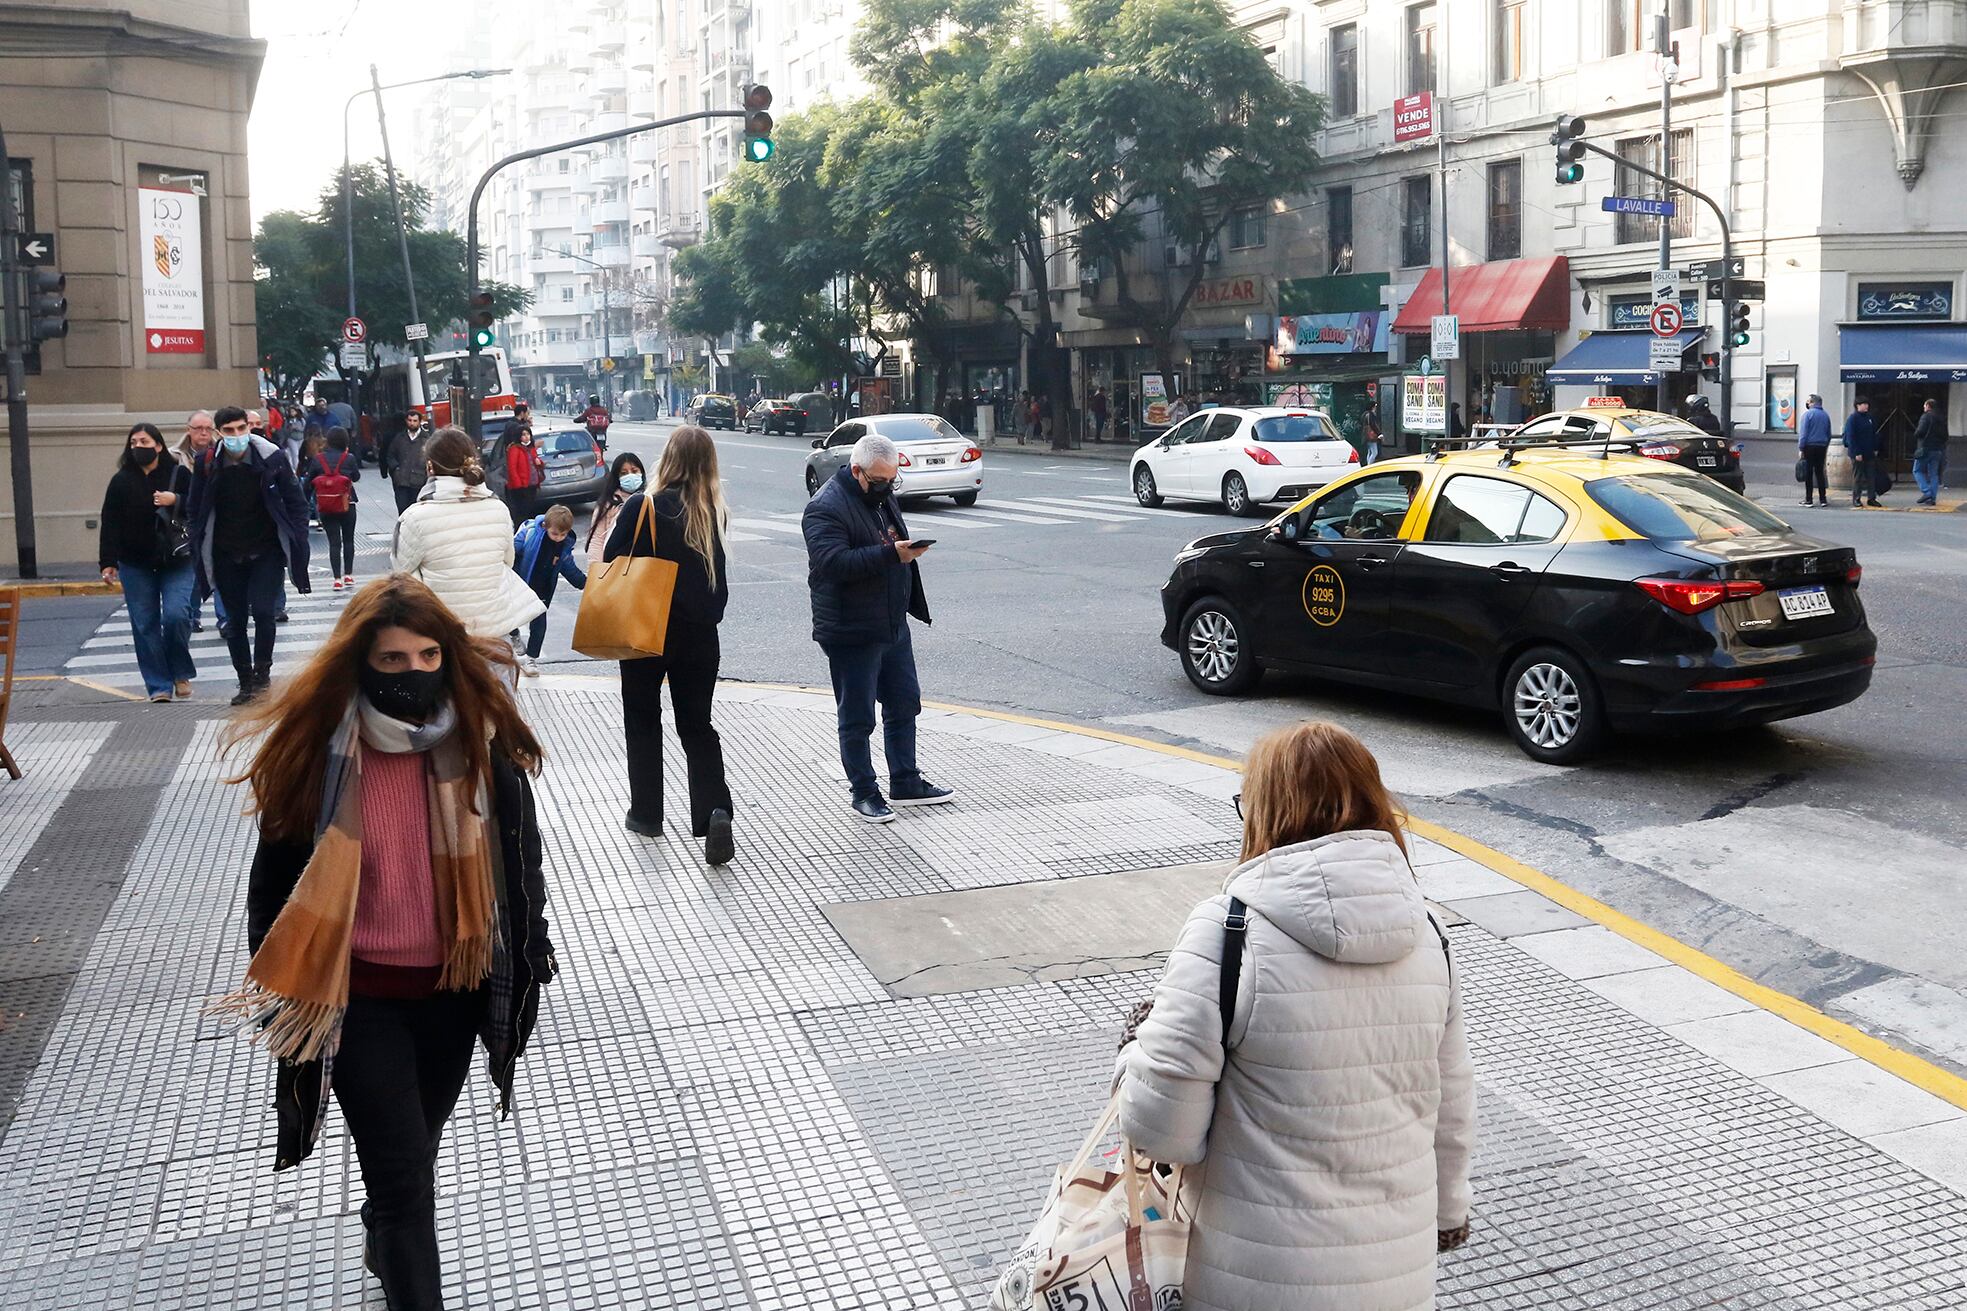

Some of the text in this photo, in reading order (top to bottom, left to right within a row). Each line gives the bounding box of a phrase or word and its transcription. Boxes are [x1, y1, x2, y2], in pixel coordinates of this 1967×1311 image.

[1397, 108, 1429, 124] VENDE
[153, 198, 182, 220] 150
[1616, 199, 1662, 214] LAVALLE
[143, 288, 198, 298] DEL SALVADOR
[1197, 280, 1254, 302] BAZAR
[164, 336, 194, 346] JESUITAS
[1491, 360, 1545, 377] b.young
[1407, 382, 1424, 394] COMA
[1427, 382, 1444, 394] COMA
[1407, 395, 1423, 407] SANO
[1427, 395, 1444, 407] SANO
[1314, 574, 1334, 583] TAXI
[1312, 587, 1334, 603] 9295
[1784, 593, 1827, 612] AC 814 AP
[1311, 606, 1336, 617] GCBA
